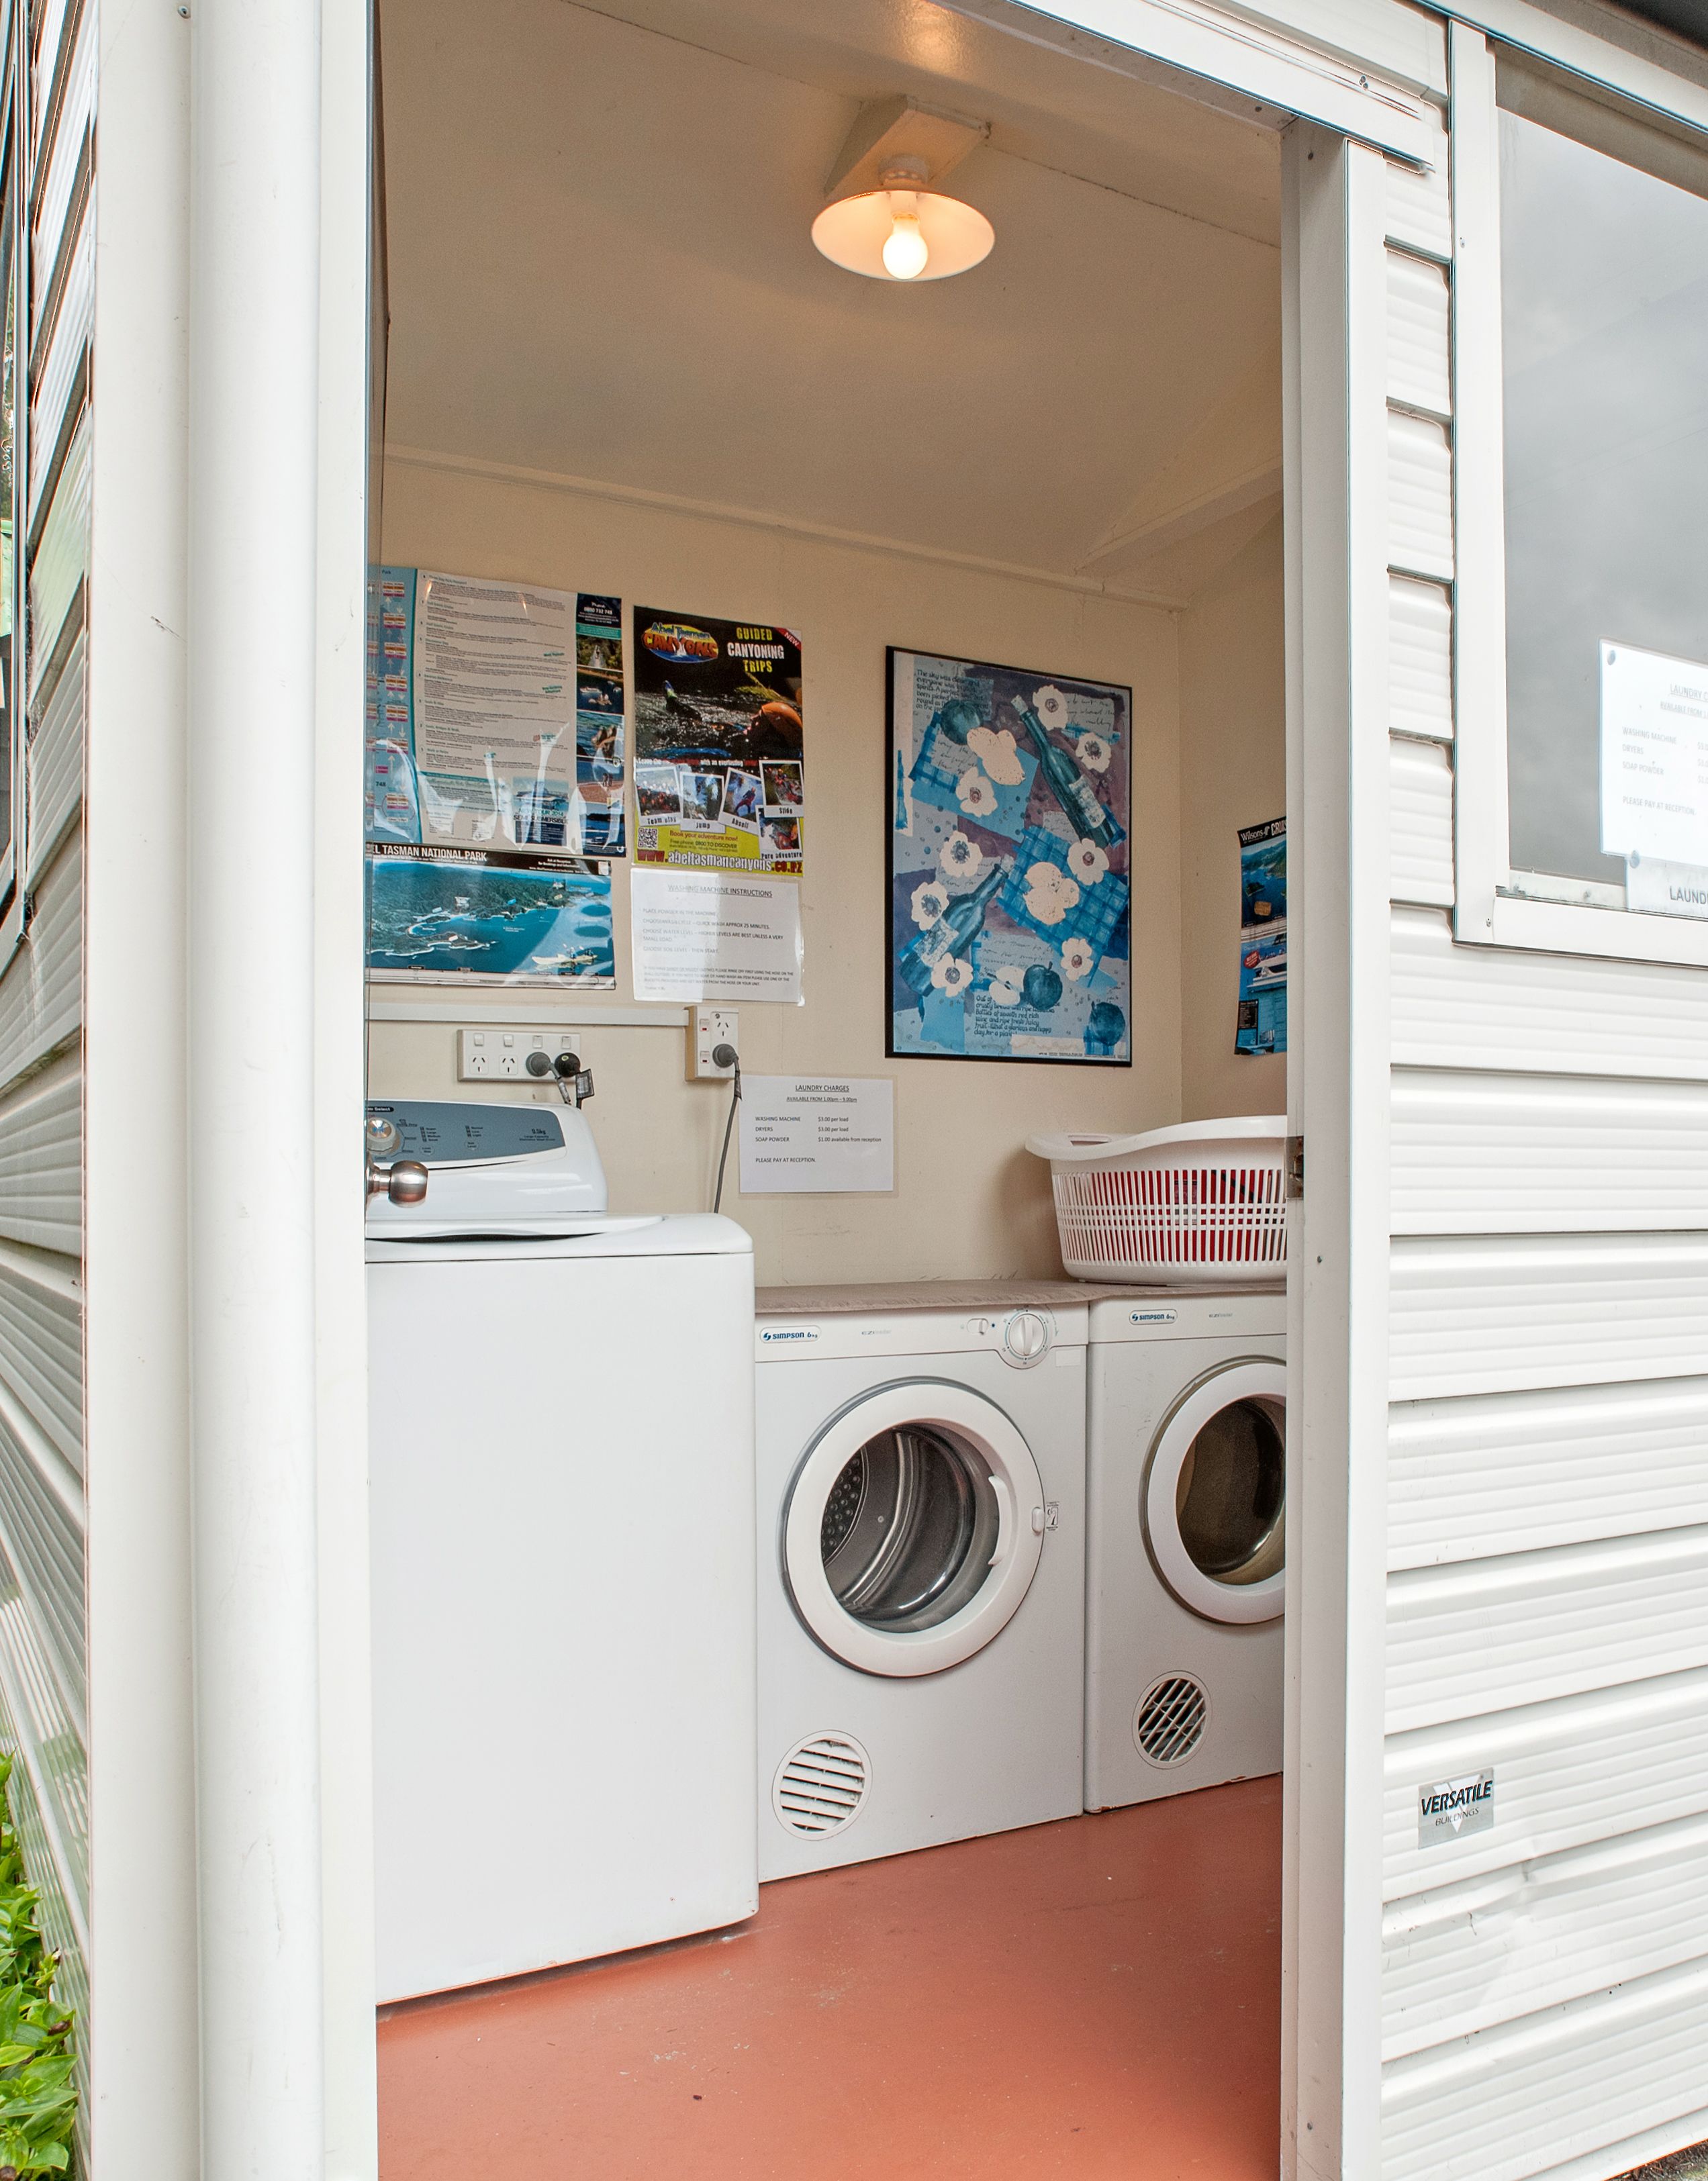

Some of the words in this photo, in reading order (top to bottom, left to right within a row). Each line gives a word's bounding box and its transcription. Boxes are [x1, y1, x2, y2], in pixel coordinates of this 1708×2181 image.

[651, 622, 674, 635] Abel
[737, 627, 773, 641] GUIDED
[642, 632, 718, 658] CANYONS
[784, 632, 800, 646] NEW
[727, 642, 784, 659] CANYONING
[743, 659, 773, 673] TRIPS
[1670, 683, 1703, 700] LAUNDRY
[1622, 726, 1650, 739] WASHING
[1651, 732, 1676, 744] MACHINE
[1622, 744, 1644, 755] DRYERS
[1622, 761, 1638, 770] SOAP
[1639, 764, 1664, 775] POWDER
[1623, 795, 1643, 806] PLEASE
[1644, 799, 1656, 808] PAY
[1656, 801, 1664, 810] AT
[1241, 830, 1264, 841] Wilsons
[382, 844, 419, 857] TASMAN
[421, 847, 463, 860] NATIONAL
[465, 851, 487, 862] PARK
[667, 884, 699, 893] WASHING
[700, 886, 729, 895] MACHINE
[730, 887, 773, 898] INSTRUCTIONS
[1670, 885, 1708, 904] LAUND
[974, 1029, 985, 1037] day
[1421, 1780, 1493, 1816] VERSATILE
[1435, 1806, 1480, 1827] BUILDINGS
